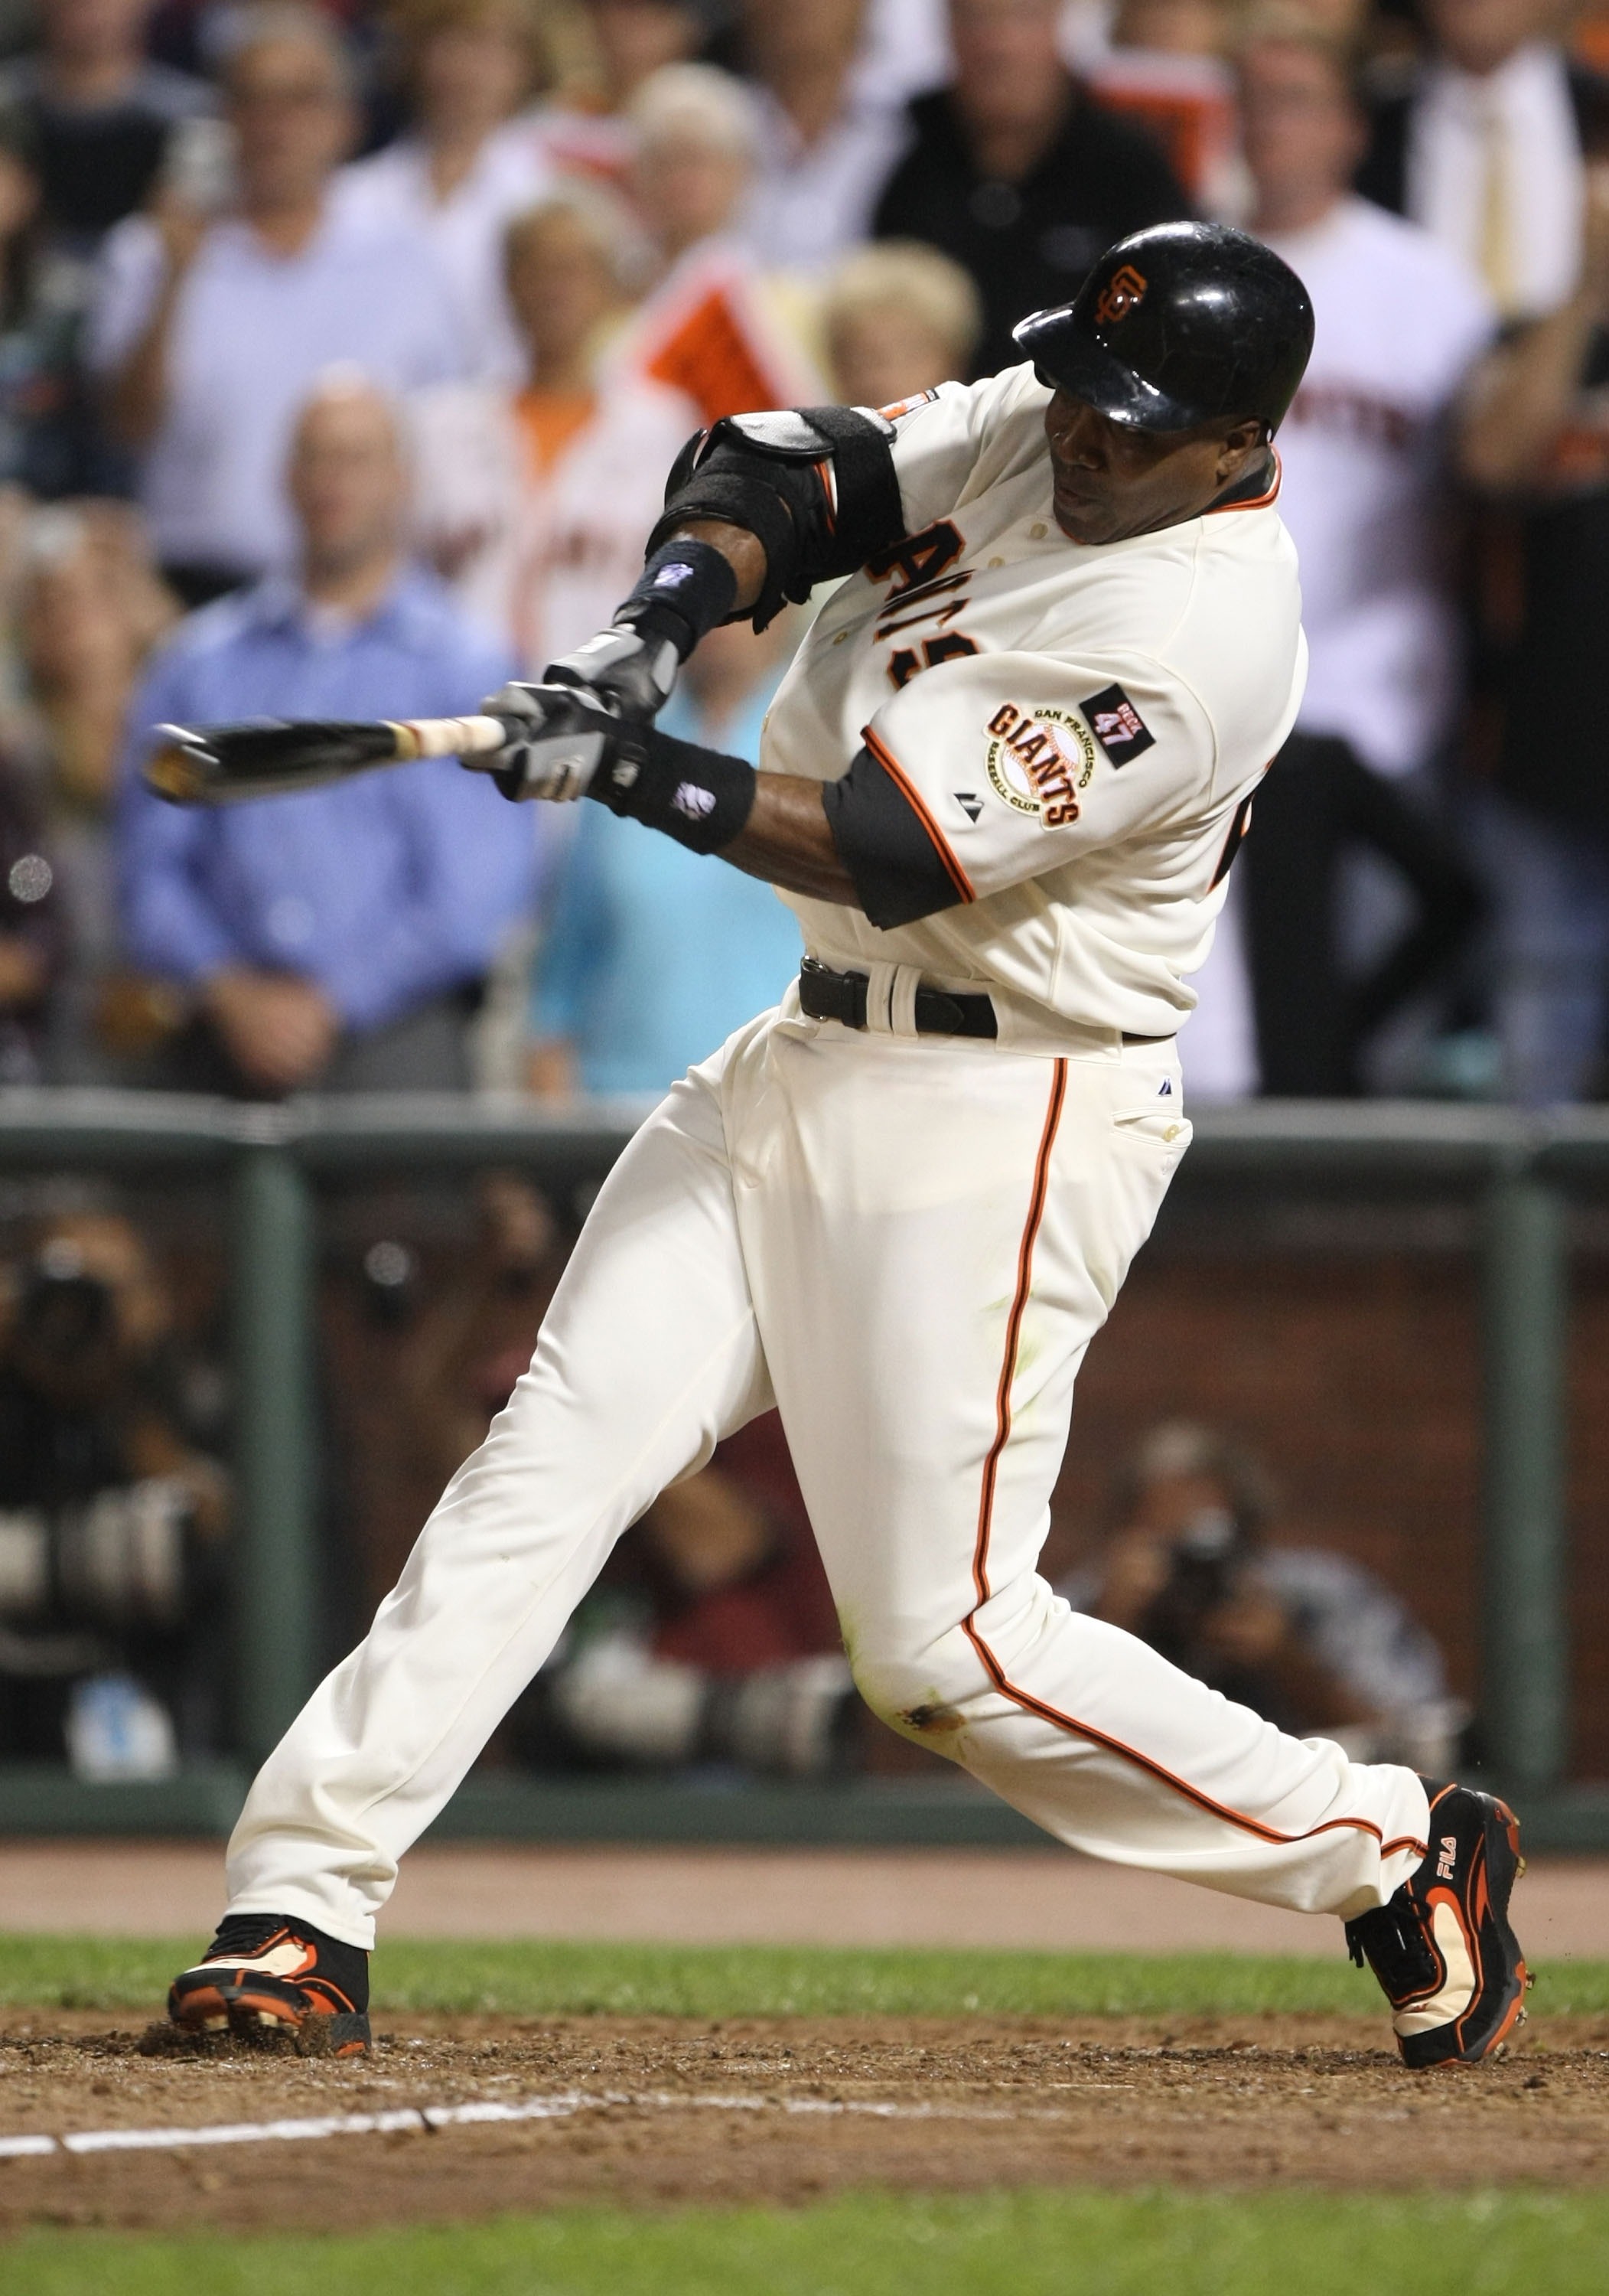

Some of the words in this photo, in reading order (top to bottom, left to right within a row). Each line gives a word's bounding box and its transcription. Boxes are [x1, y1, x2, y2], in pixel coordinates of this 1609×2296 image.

[1095, 264, 1147, 325] SF
[1034, 709, 1063, 720] SAN
[1064, 716, 1096, 788] FRANCISCO
[1094, 713, 1134, 746] 47
[987, 703, 1080, 825] GIANTS
[988, 741, 1008, 799] BASEBALL
[1010, 797, 1040, 812] CLUB
[1437, 1837, 1457, 1880] FILA
